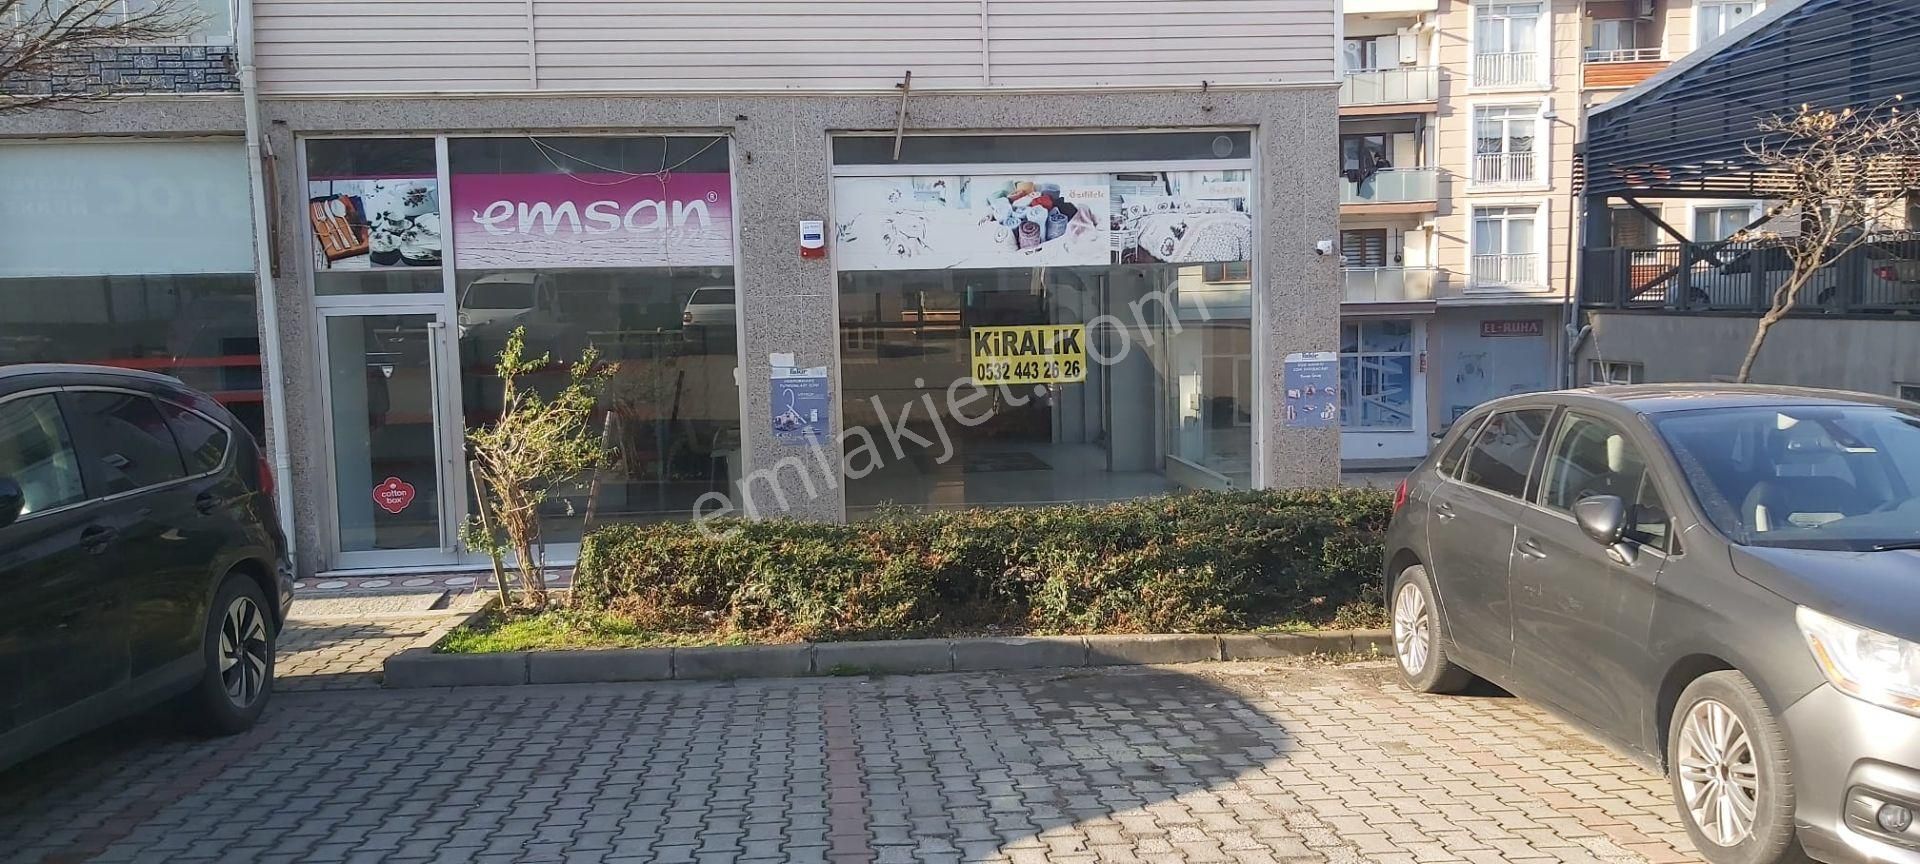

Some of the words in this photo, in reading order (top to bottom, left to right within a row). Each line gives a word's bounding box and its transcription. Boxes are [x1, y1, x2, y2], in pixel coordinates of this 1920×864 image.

[472, 199, 712, 235] emsan
[1484, 322, 1538, 333] EL-RUHA
[977, 363, 1010, 380] 0532
[1014, 361, 1039, 379] 443
[1043, 361, 1059, 378] 26
[1064, 360, 1081, 378] 26
[381, 490, 407, 498] cotton
